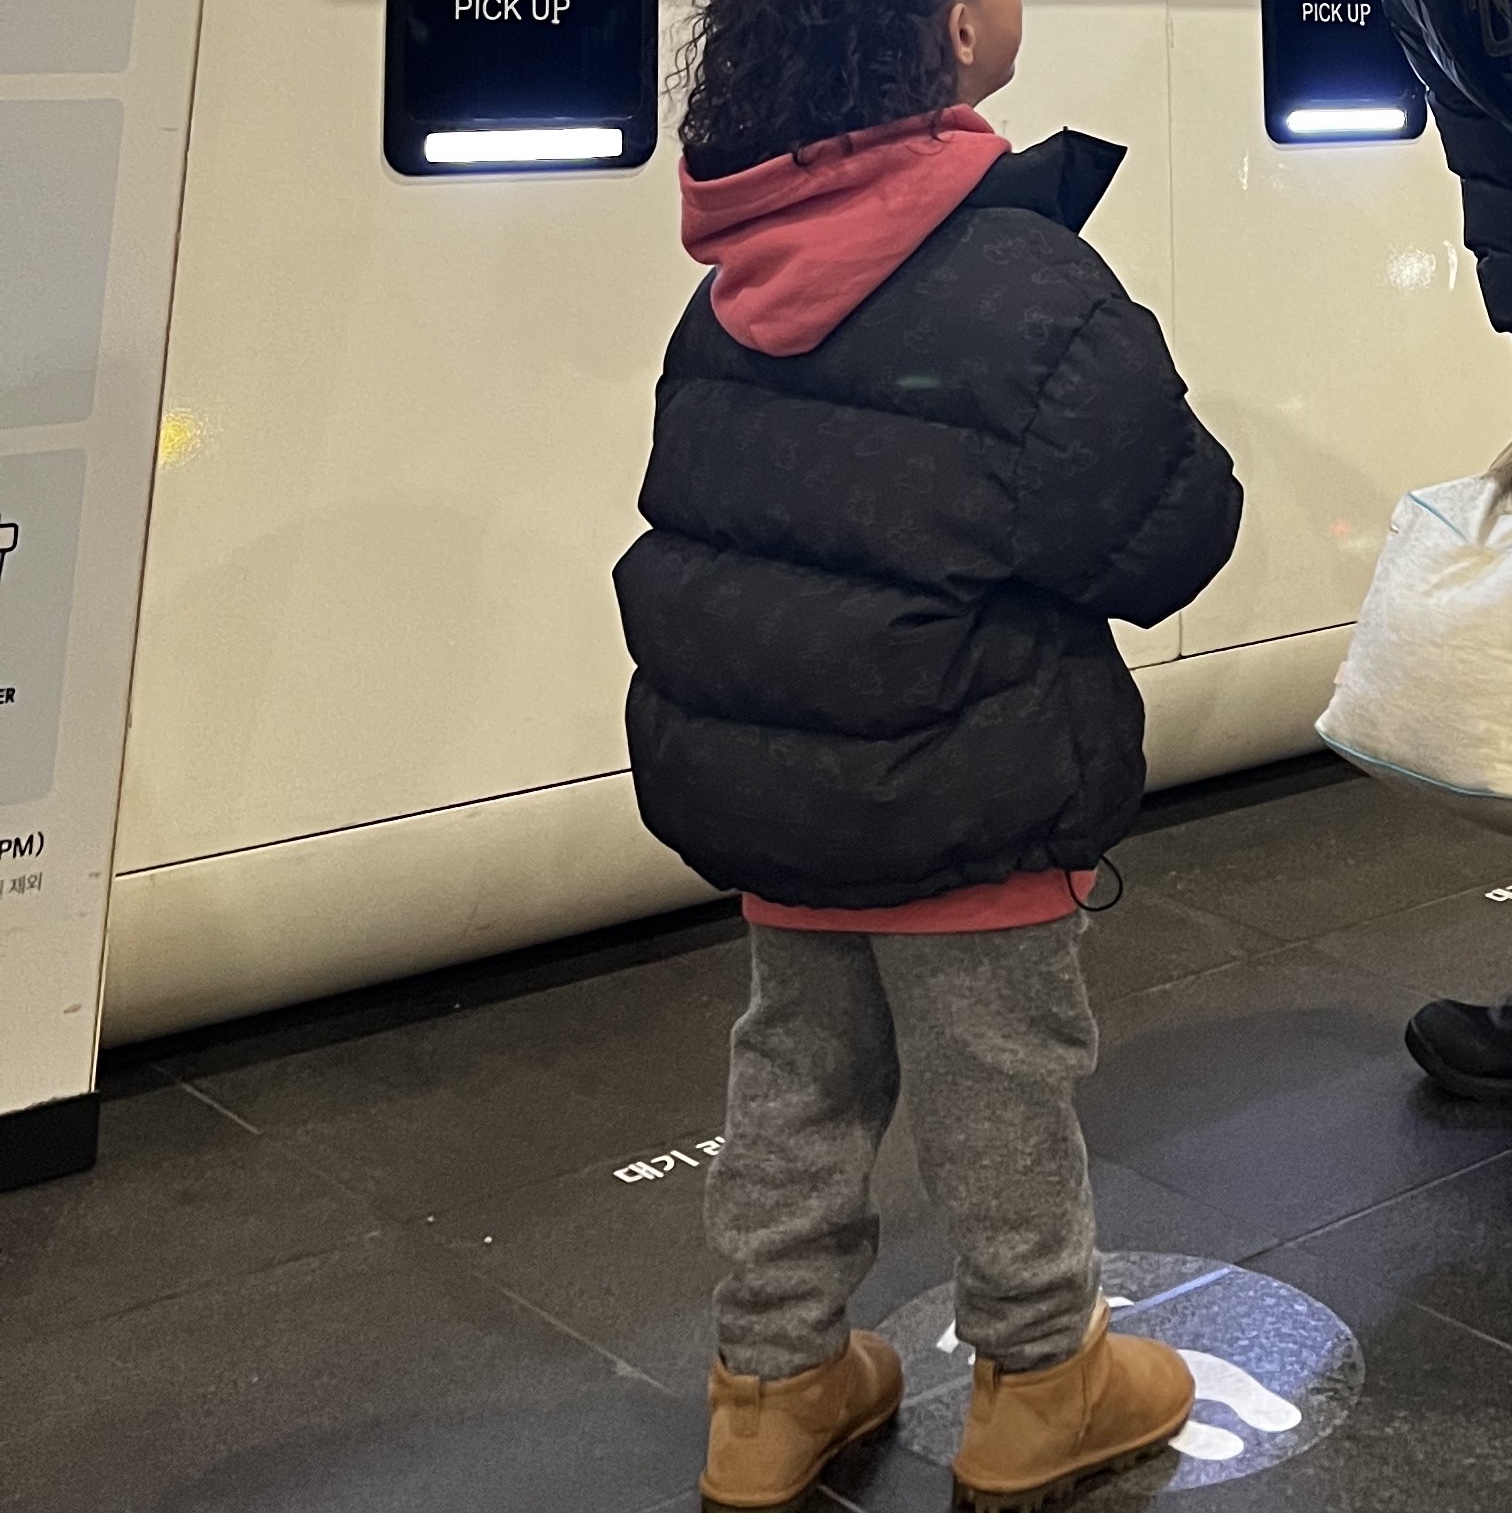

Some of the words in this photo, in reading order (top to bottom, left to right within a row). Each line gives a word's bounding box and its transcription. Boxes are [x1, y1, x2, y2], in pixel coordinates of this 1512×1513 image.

[1302, 2, 1344, 23] PICK
[1347, 3, 1372, 26] UP
[613, 1150, 700, 1183] 대기
